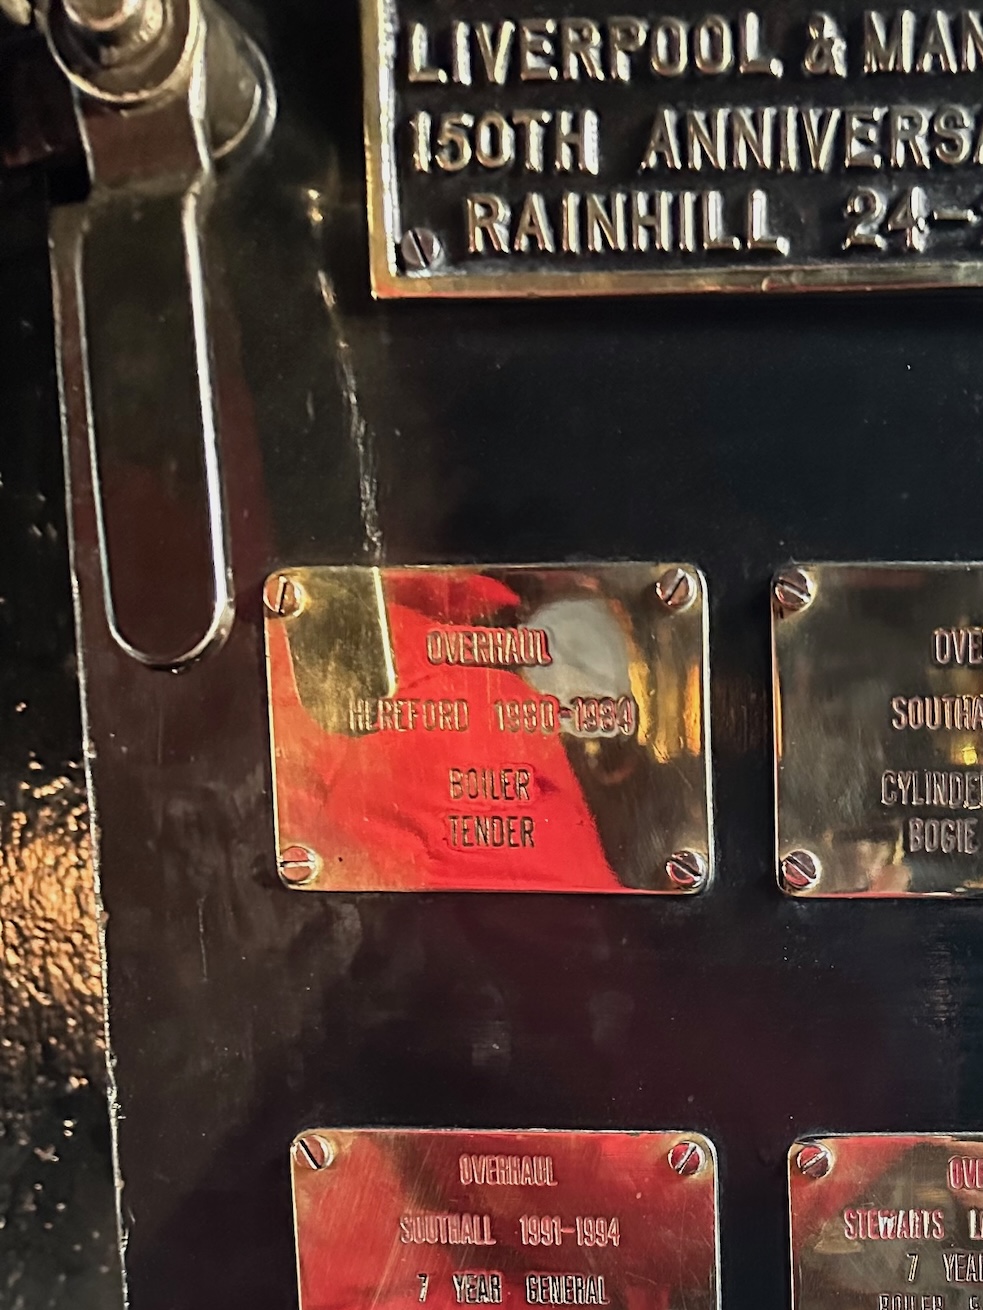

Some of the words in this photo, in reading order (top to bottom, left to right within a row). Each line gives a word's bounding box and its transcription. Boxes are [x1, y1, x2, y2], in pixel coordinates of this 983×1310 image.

[408, 12, 783, 84] LIVERPOOL
[803, 14, 848, 77] &
[409, 109, 600, 175] 150TH
[466, 189, 790, 256] RAINHILL
[426, 628, 552, 665] OVERHAUL
[348, 698, 469, 733] HEREFORD
[449, 768, 531, 800] BOILER
[449, 815, 535, 848] TENDER
[909, 817, 978, 853] BOGIE
[459, 1153, 558, 1186] OVERHAUL
[400, 1213, 496, 1246] SOUTHALL
[519, 1216, 621, 1247] 1991-1994
[843, 1208, 945, 1240] STEWARTS
[906, 1253, 917, 1282] 7
[417, 1273, 429, 1304] 7
[453, 1273, 501, 1304] YEAR
[526, 1274, 609, 1305] GENERAL
